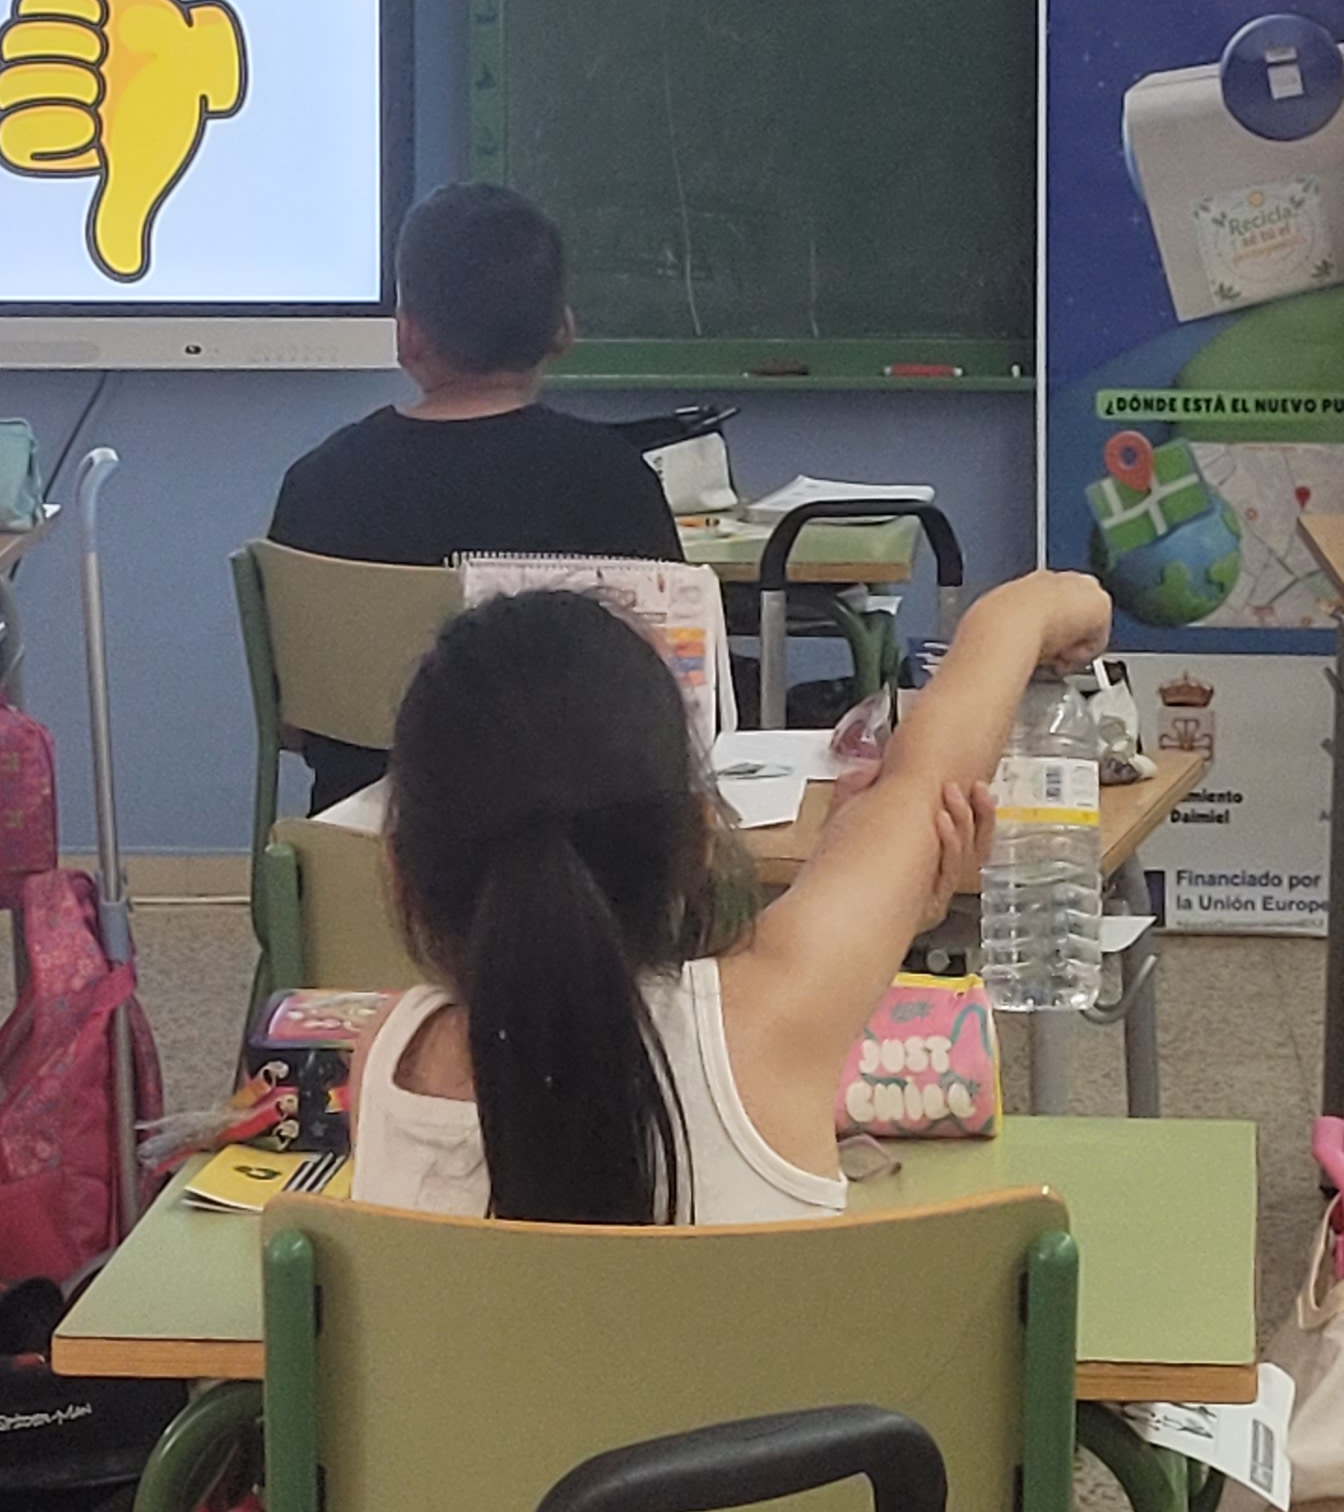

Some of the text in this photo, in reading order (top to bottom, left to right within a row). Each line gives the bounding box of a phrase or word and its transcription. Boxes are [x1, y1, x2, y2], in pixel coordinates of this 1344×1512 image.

[1105, 395, 1177, 416] ¿DÓNDE
[1182, 394, 1225, 413] ESTÁ
[1231, 398, 1250, 414] EL
[1255, 397, 1317, 414] NUEVO
[1170, 808, 1231, 825] Daimiel
[1176, 870, 1323, 893] Financiado por
[1176, 894, 1193, 912] la
[1198, 894, 1256, 912] Unión
[858, 1034, 953, 1075] JUST
